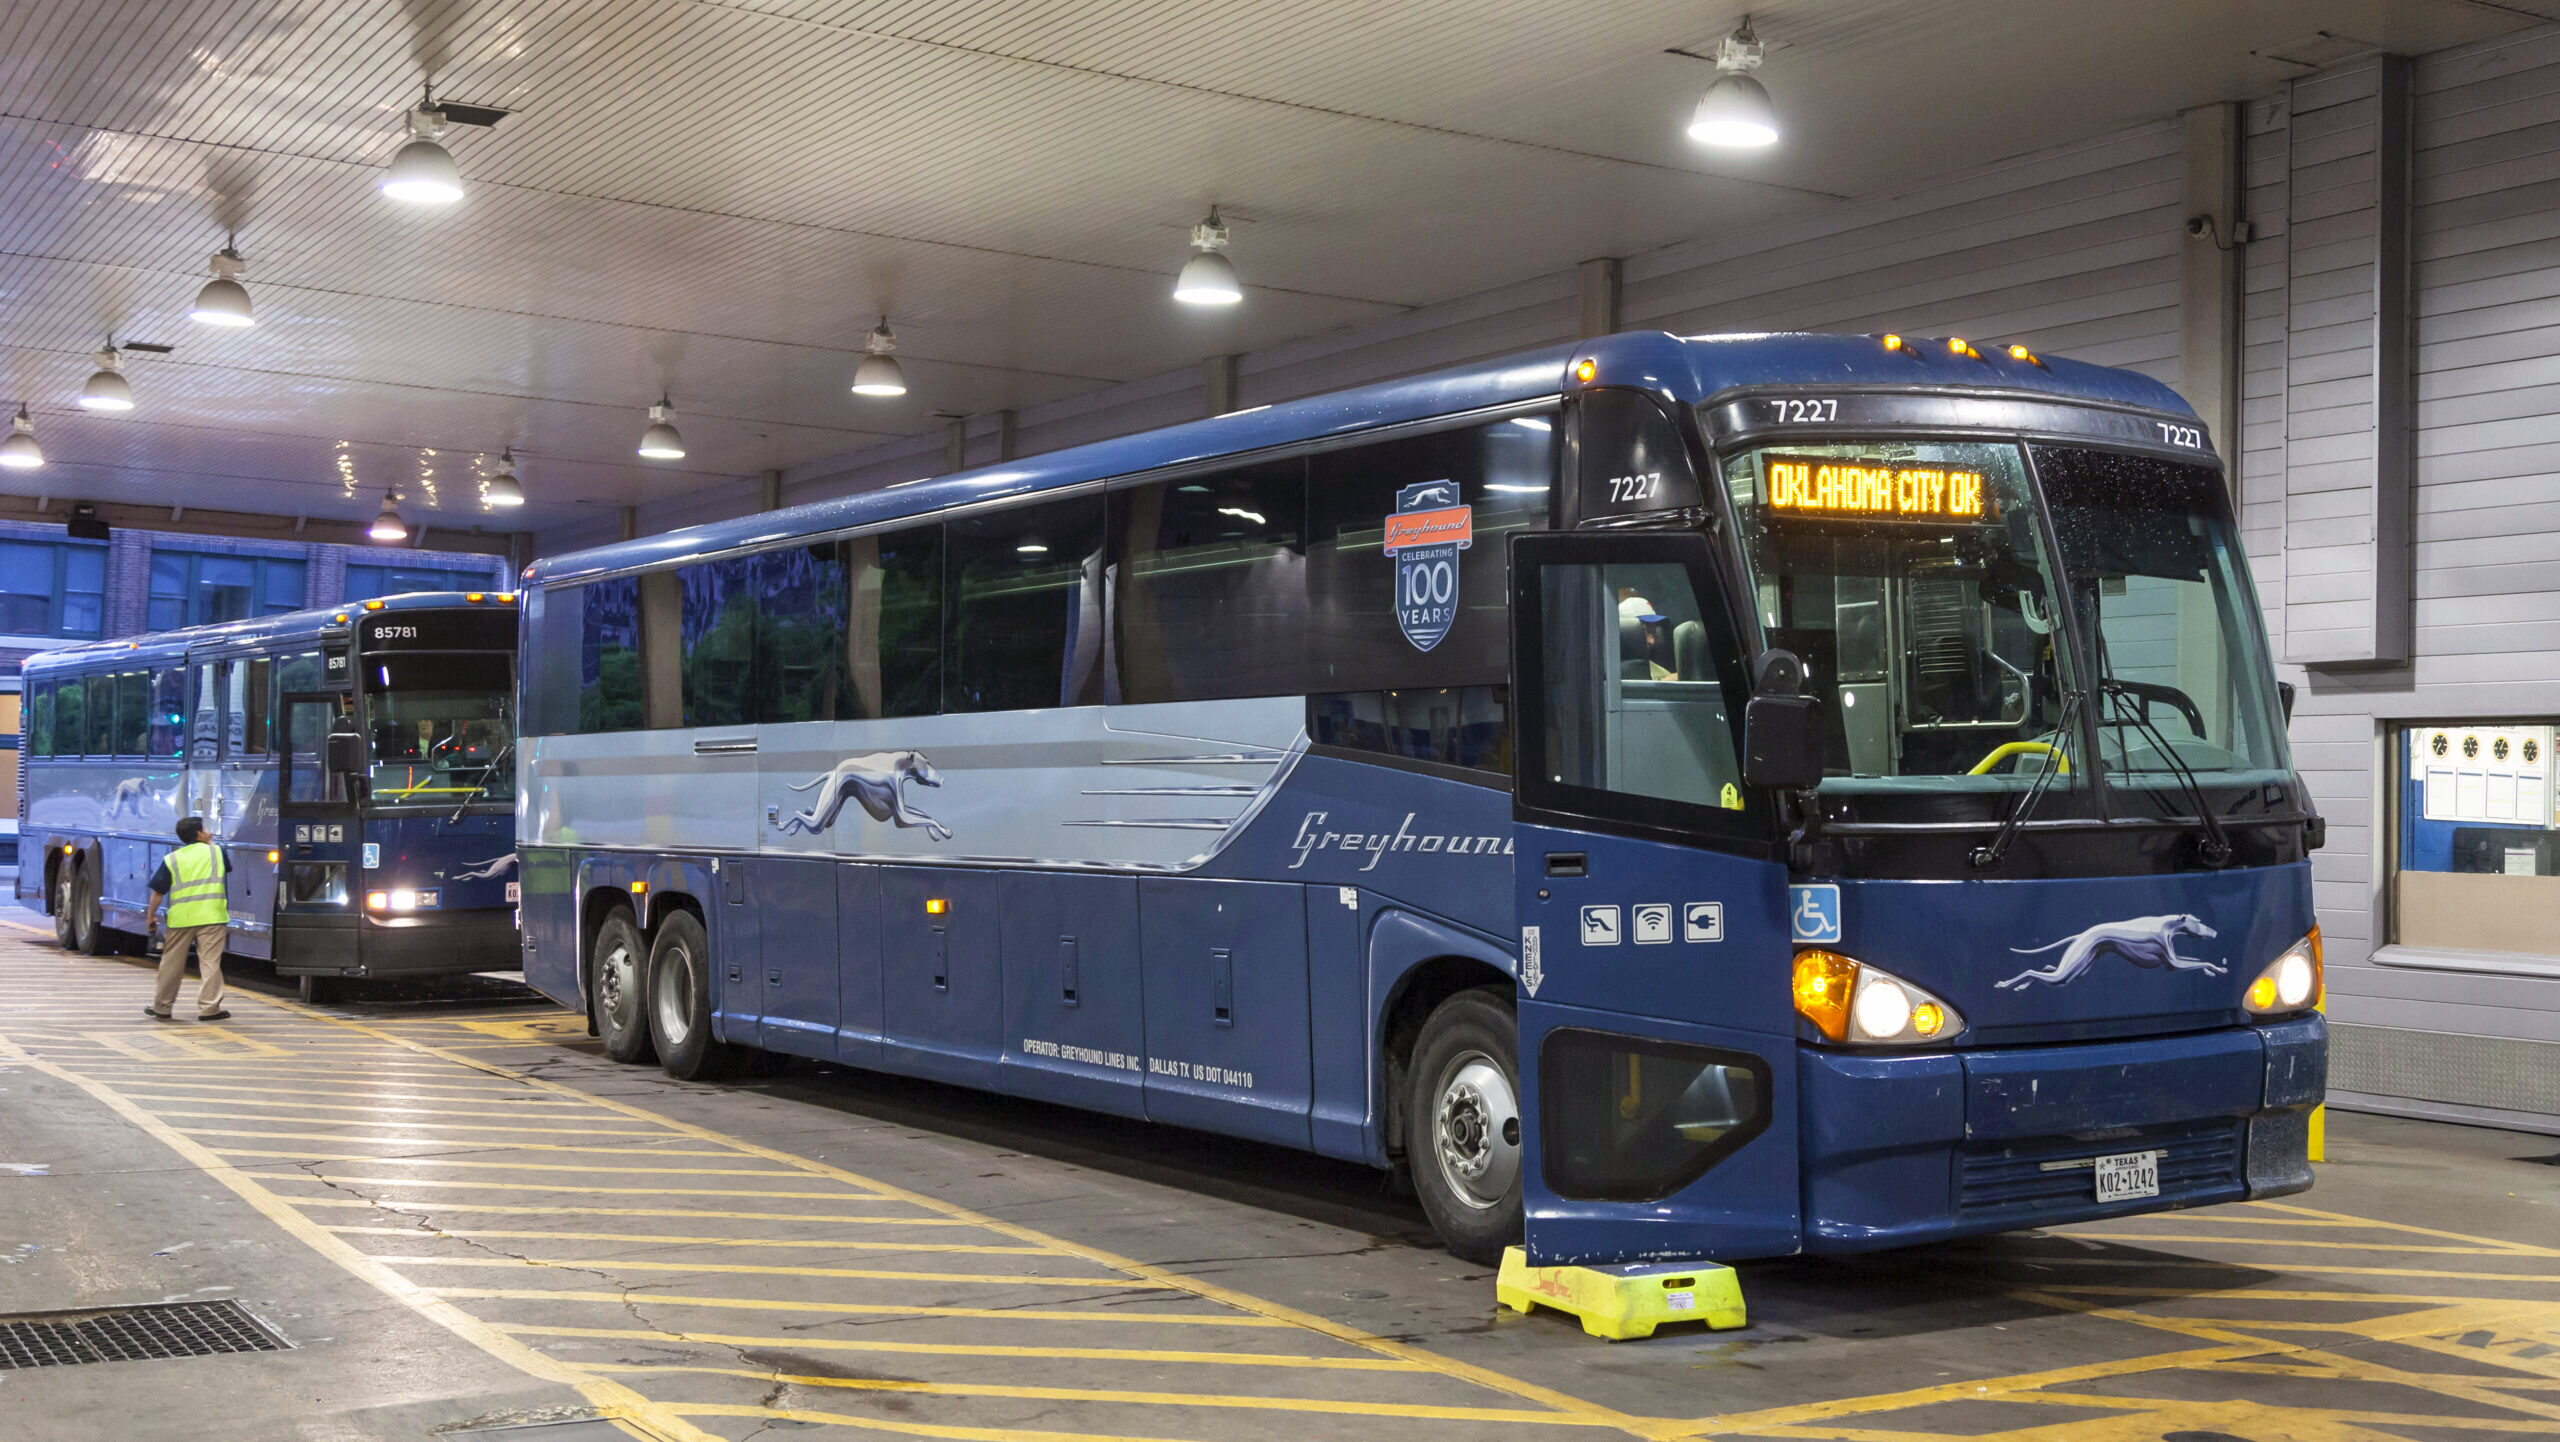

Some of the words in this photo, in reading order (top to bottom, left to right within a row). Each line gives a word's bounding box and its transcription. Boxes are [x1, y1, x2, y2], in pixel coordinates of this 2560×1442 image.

[1771, 400, 1838, 423] 7227
[2157, 422, 2201, 449] 7227
[1609, 472, 1661, 503] 7227
[1771, 463, 1892, 511] OKLAHOMA
[1898, 470, 1944, 513] CITY
[1949, 472, 1981, 515] OK
[1387, 514, 1468, 544] Greyhound
[1402, 548, 1453, 562] CELEBRATING
[1402, 561, 1453, 607] 100
[1402, 607, 1451, 625] YEARS
[374, 626, 417, 639] 85781
[328, 656, 346, 669] 85781
[1524, 936, 1533, 987] KNEELS
[1023, 1038, 1060, 1057] OPERATOR:
[1061, 1044, 1103, 1064] GREYHOUND
[1105, 1051, 1125, 1069] LINES
[1127, 1055, 1142, 1071] INC.
[1149, 1057, 1178, 1076] DALLAS
[1179, 1062, 1190, 1078] TX
[1193, 1064, 1204, 1080] US
[1206, 1066, 1222, 1083] DOT
[1223, 1069, 1253, 1088] 044110
[2115, 1156, 2139, 1167] TEXAS
